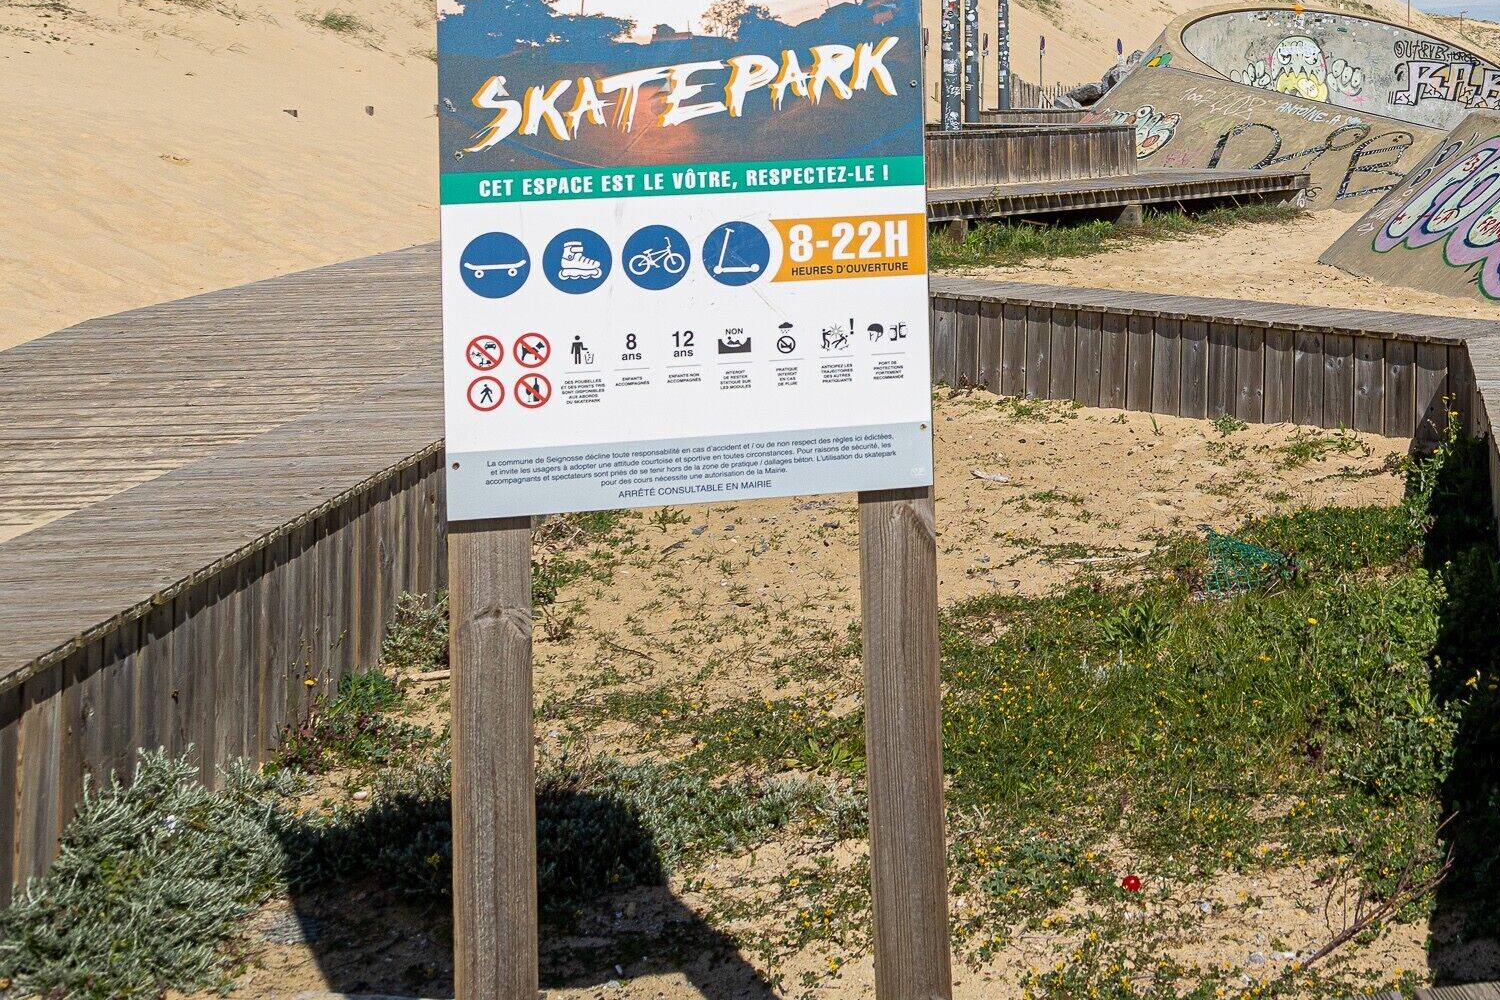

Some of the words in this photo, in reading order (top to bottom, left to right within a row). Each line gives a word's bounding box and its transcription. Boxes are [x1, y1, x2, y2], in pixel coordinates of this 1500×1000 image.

[463, 36, 900, 153] SKATEPARK
[479, 178, 514, 197] CET
[522, 176, 593, 196] ESPACE
[601, 174, 635, 192] EST
[643, 173, 664, 190] LE
[672, 168, 738, 190] VÔTRE,
[746, 164, 875, 186] RESPECTEZ-LE
[882, 164, 889, 181] !
[788, 219, 909, 263] 8-22H
[791, 265, 834, 277] HEURES
[836, 261, 909, 274] D'OUVERTURE
[626, 333, 637, 350] 8
[672, 330, 694, 348] 12
[621, 352, 642, 361] ans
[673, 349, 694, 358] ans
[498, 459, 534, 467] commune
[535, 456, 545, 464] de
[546, 455, 583, 464] Seignosse
[585, 452, 611, 460] décline
[632, 447, 680, 457] responsabilité
[766, 440, 775, 448] de
[791, 438, 817, 447] respect
[818, 436, 831, 444] des
[832, 434, 854, 444] règles
[855, 434, 863, 442] ici
[499, 467, 519, 475] invite
[532, 465, 561, 474] usagers
[569, 463, 596, 471] adopter
[683, 455, 711, 464] sportive
[723, 452, 745, 460] toutes
[746, 449, 794, 458] circonstances.
[796, 447, 813, 455] Pour
[840, 444, 850, 452] de
[881, 441, 892, 449] les
[485, 476, 541, 486] accompagnants
[551, 472, 592, 481] spectateurs
[610, 470, 628, 478] priés
[650, 466, 665, 474] tenir
[667, 465, 682, 473] hors
[694, 463, 700, 471] la
[720, 461, 729, 469] de
[731, 459, 759, 469] pratique
[764, 456, 793, 466] dallages
[855, 452, 863, 460] du
[864, 450, 897, 459] skatepark
[618, 477, 632, 485] des
[654, 474, 688, 482] nécessite
[704, 470, 745, 479] autorisation
[746, 468, 755, 476] de
[757, 467, 763, 475] la
[618, 486, 656, 498] ARRÊTÉ
[658, 483, 724, 496] CONSULTABLE
[725, 482, 739, 491] EN
[740, 479, 772, 489] MAIRIE
